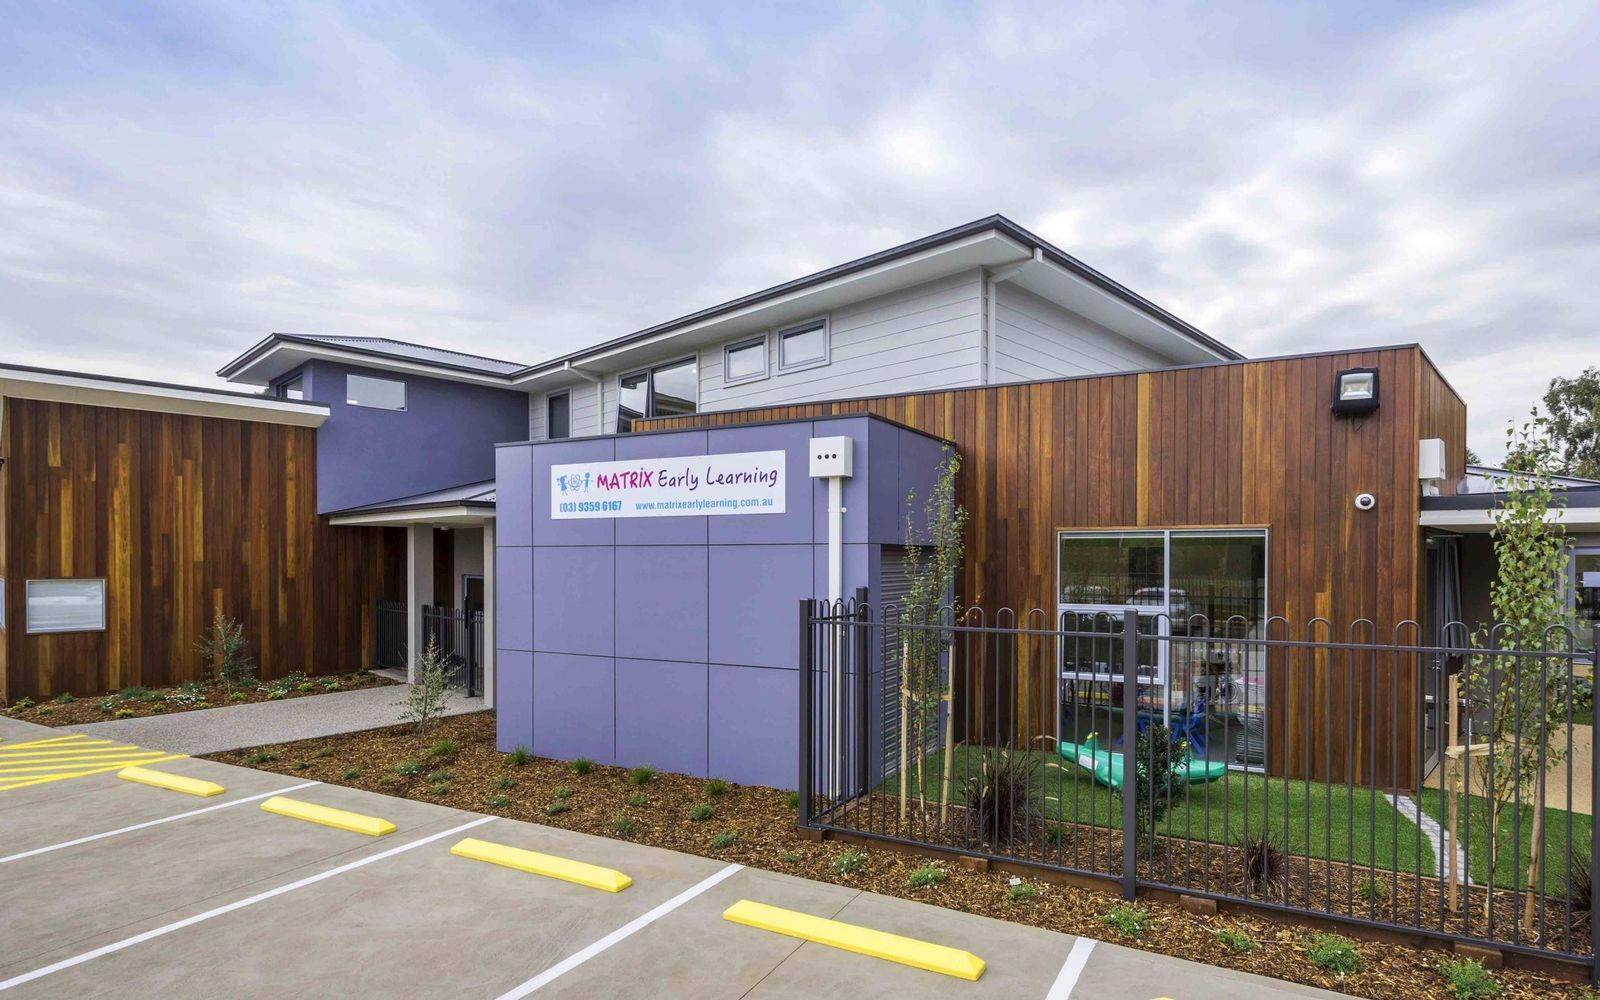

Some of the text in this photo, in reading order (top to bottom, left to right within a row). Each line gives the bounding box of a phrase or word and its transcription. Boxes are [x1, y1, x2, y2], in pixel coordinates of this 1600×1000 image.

[658, 467, 699, 491] Early
[706, 466, 778, 488] Learning
[559, 497, 773, 513] (03) 9359 6167 www.matrixearlylearning.com.au
